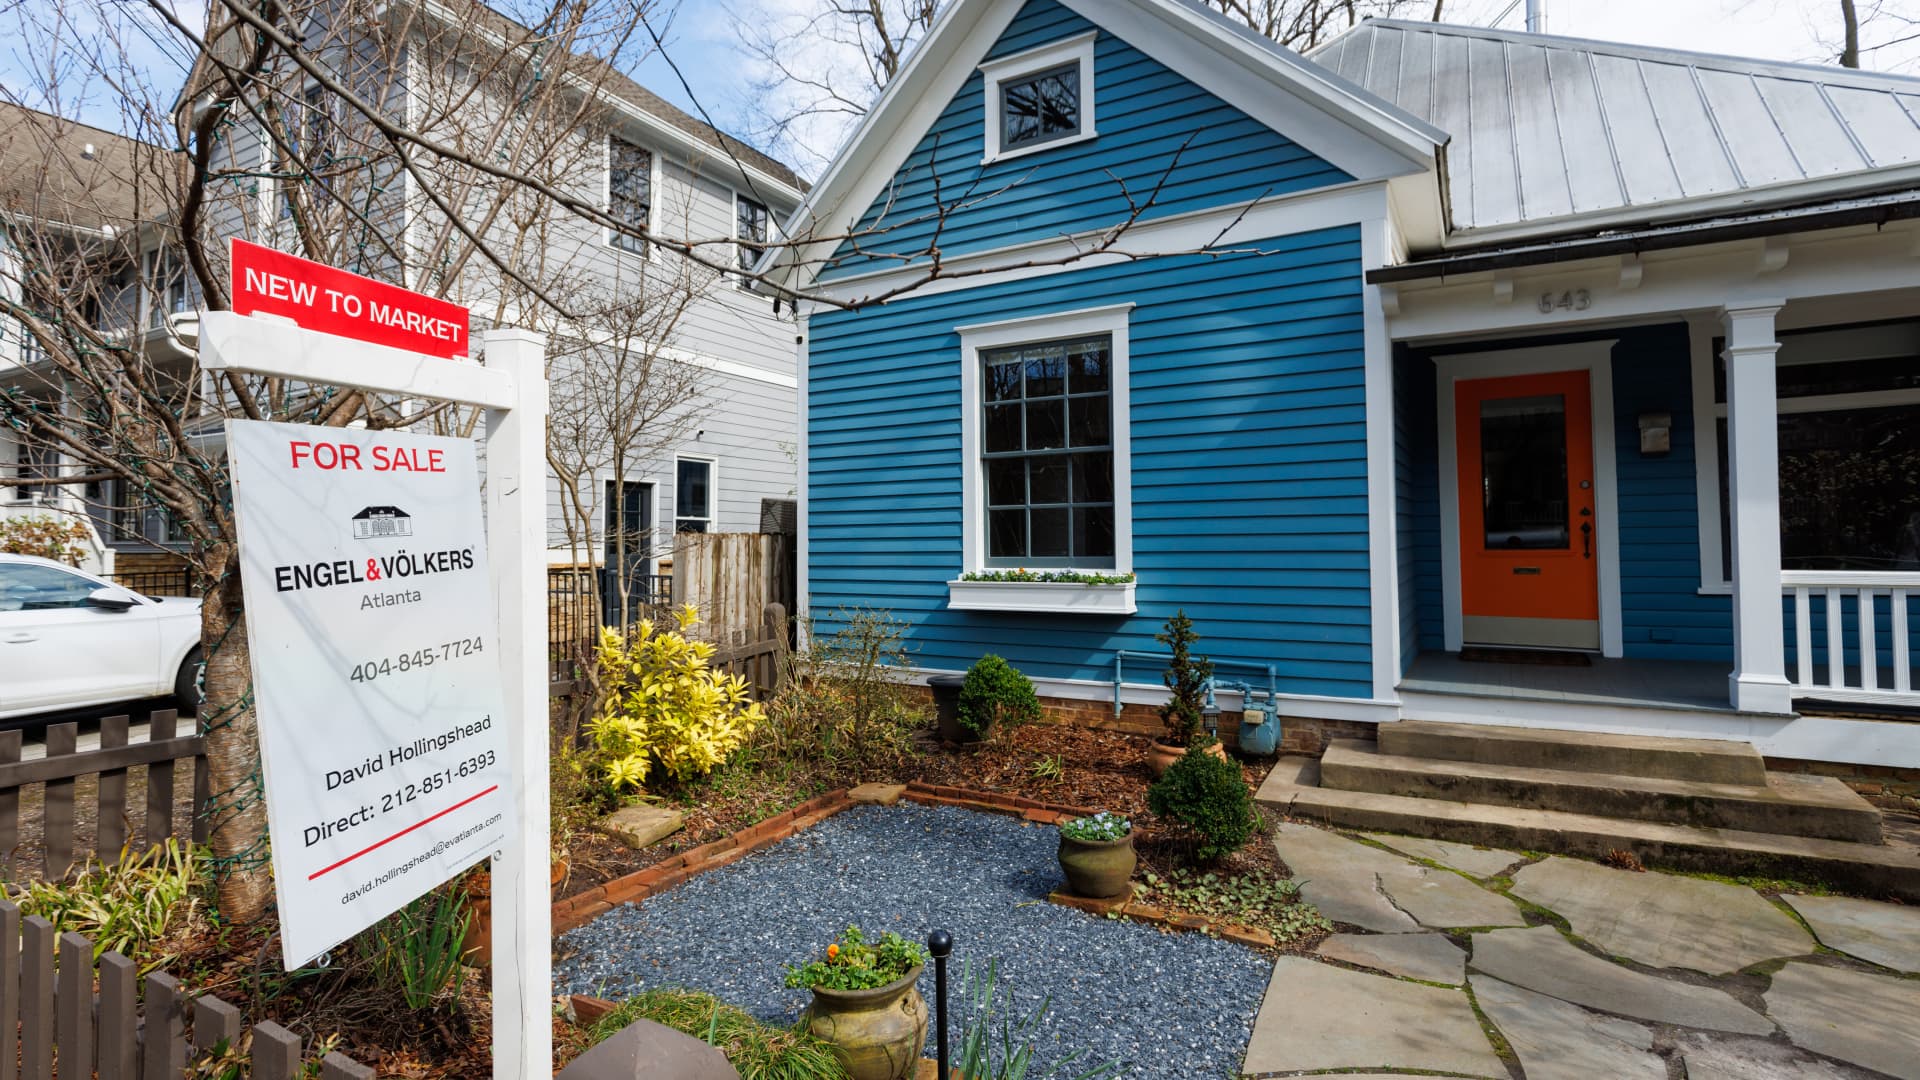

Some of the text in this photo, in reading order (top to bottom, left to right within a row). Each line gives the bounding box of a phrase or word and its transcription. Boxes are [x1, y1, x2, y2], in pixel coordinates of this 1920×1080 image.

[244, 267, 462, 342] NEW TO MARKET
[290, 441, 446, 473] FOR SALE
[360, 589, 422, 610] Atlanta
[350, 636, 483, 683] 404-845-7724
[326, 715, 492, 791] David Hollingshead
[304, 750, 496, 847] Direct: 212-851-6393
[341, 813, 502, 905] david.hollingshead@evatlanta.com
